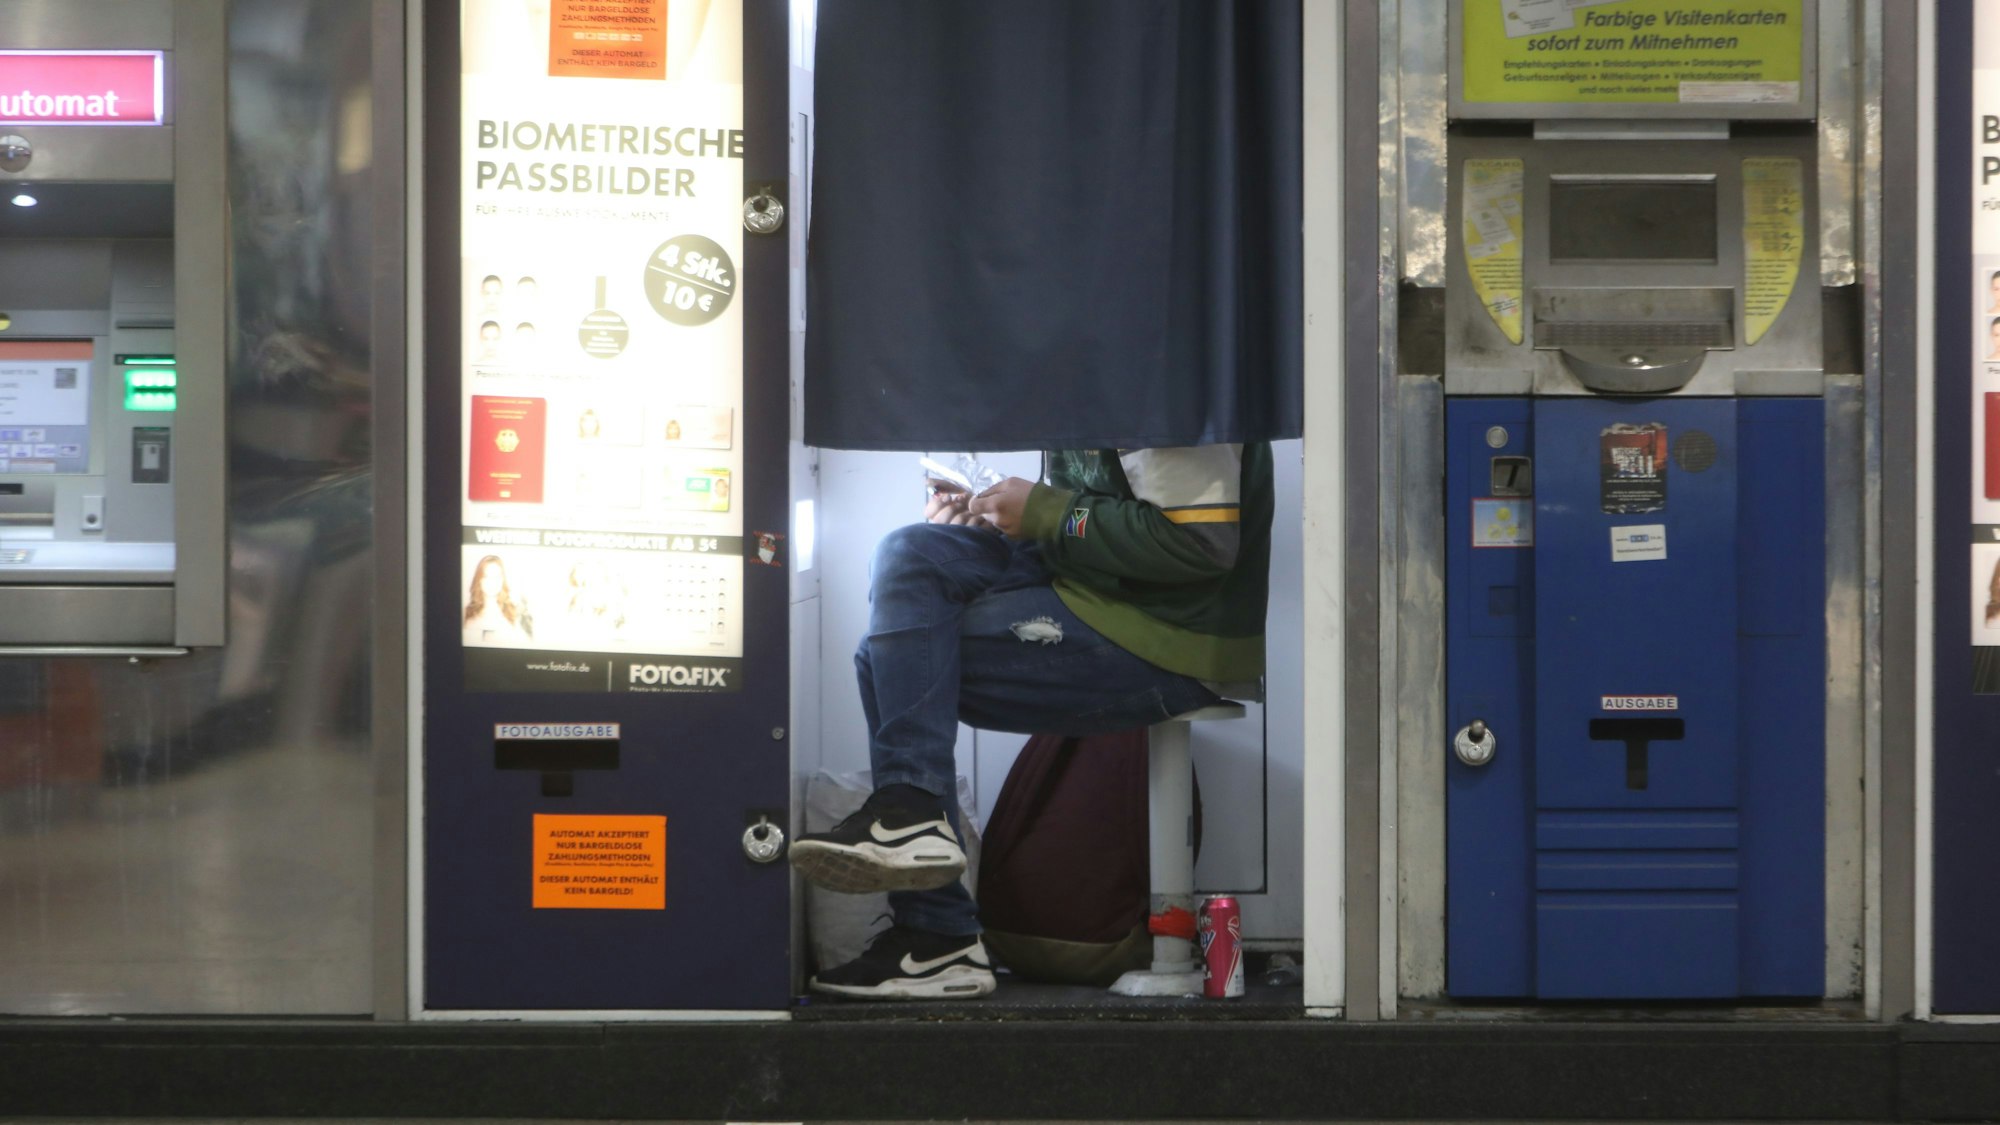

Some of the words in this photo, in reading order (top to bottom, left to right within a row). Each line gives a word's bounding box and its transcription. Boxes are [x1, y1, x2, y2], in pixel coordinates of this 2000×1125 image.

[588, 6, 650, 14] BARGELDLOSE
[561, 14, 656, 24] ZAHLUNGSMETHODEN
[1584, 10, 1657, 30] Farbige
[1664, 9, 1787, 27] Visitenkarten
[1527, 35, 1580, 51] sofort
[1585, 37, 1625, 51] zum
[1629, 35, 1738, 50] Mitnehmen
[572, 49, 601, 57] DIESER
[603, 50, 643, 58] AUTOMAT
[617, 60, 657, 68] BARGELD
[1503, 60, 1592, 70] Empfehlungskarten
[1503, 73, 1588, 83] Geburtsanzeigen
[1579, 86, 1597, 94] und
[1600, 86, 1623, 94] noch
[478, 119, 743, 159] BIOMETRISCHE
[477, 161, 696, 197] PASSBILDER
[659, 244, 680, 268] 4
[681, 251, 731, 287] Stk.
[526, 661, 591, 673] www.fotofix.de
[1605, 698, 1675, 709] AUSGABE
[501, 726, 613, 737] FOTOAUSGABE
[550, 830, 595, 838] AUTOMAT
[597, 831, 649, 839] AKZEPTIERT
[578, 842, 643, 850] BARGELDLOSE
[548, 853, 651, 861] ZAHLUNGSMETHODEN
[572, 876, 617, 884] AUTOMAT
[620, 874, 659, 884] ENTHÄLT
[589, 888, 634, 896] BARGELD!
